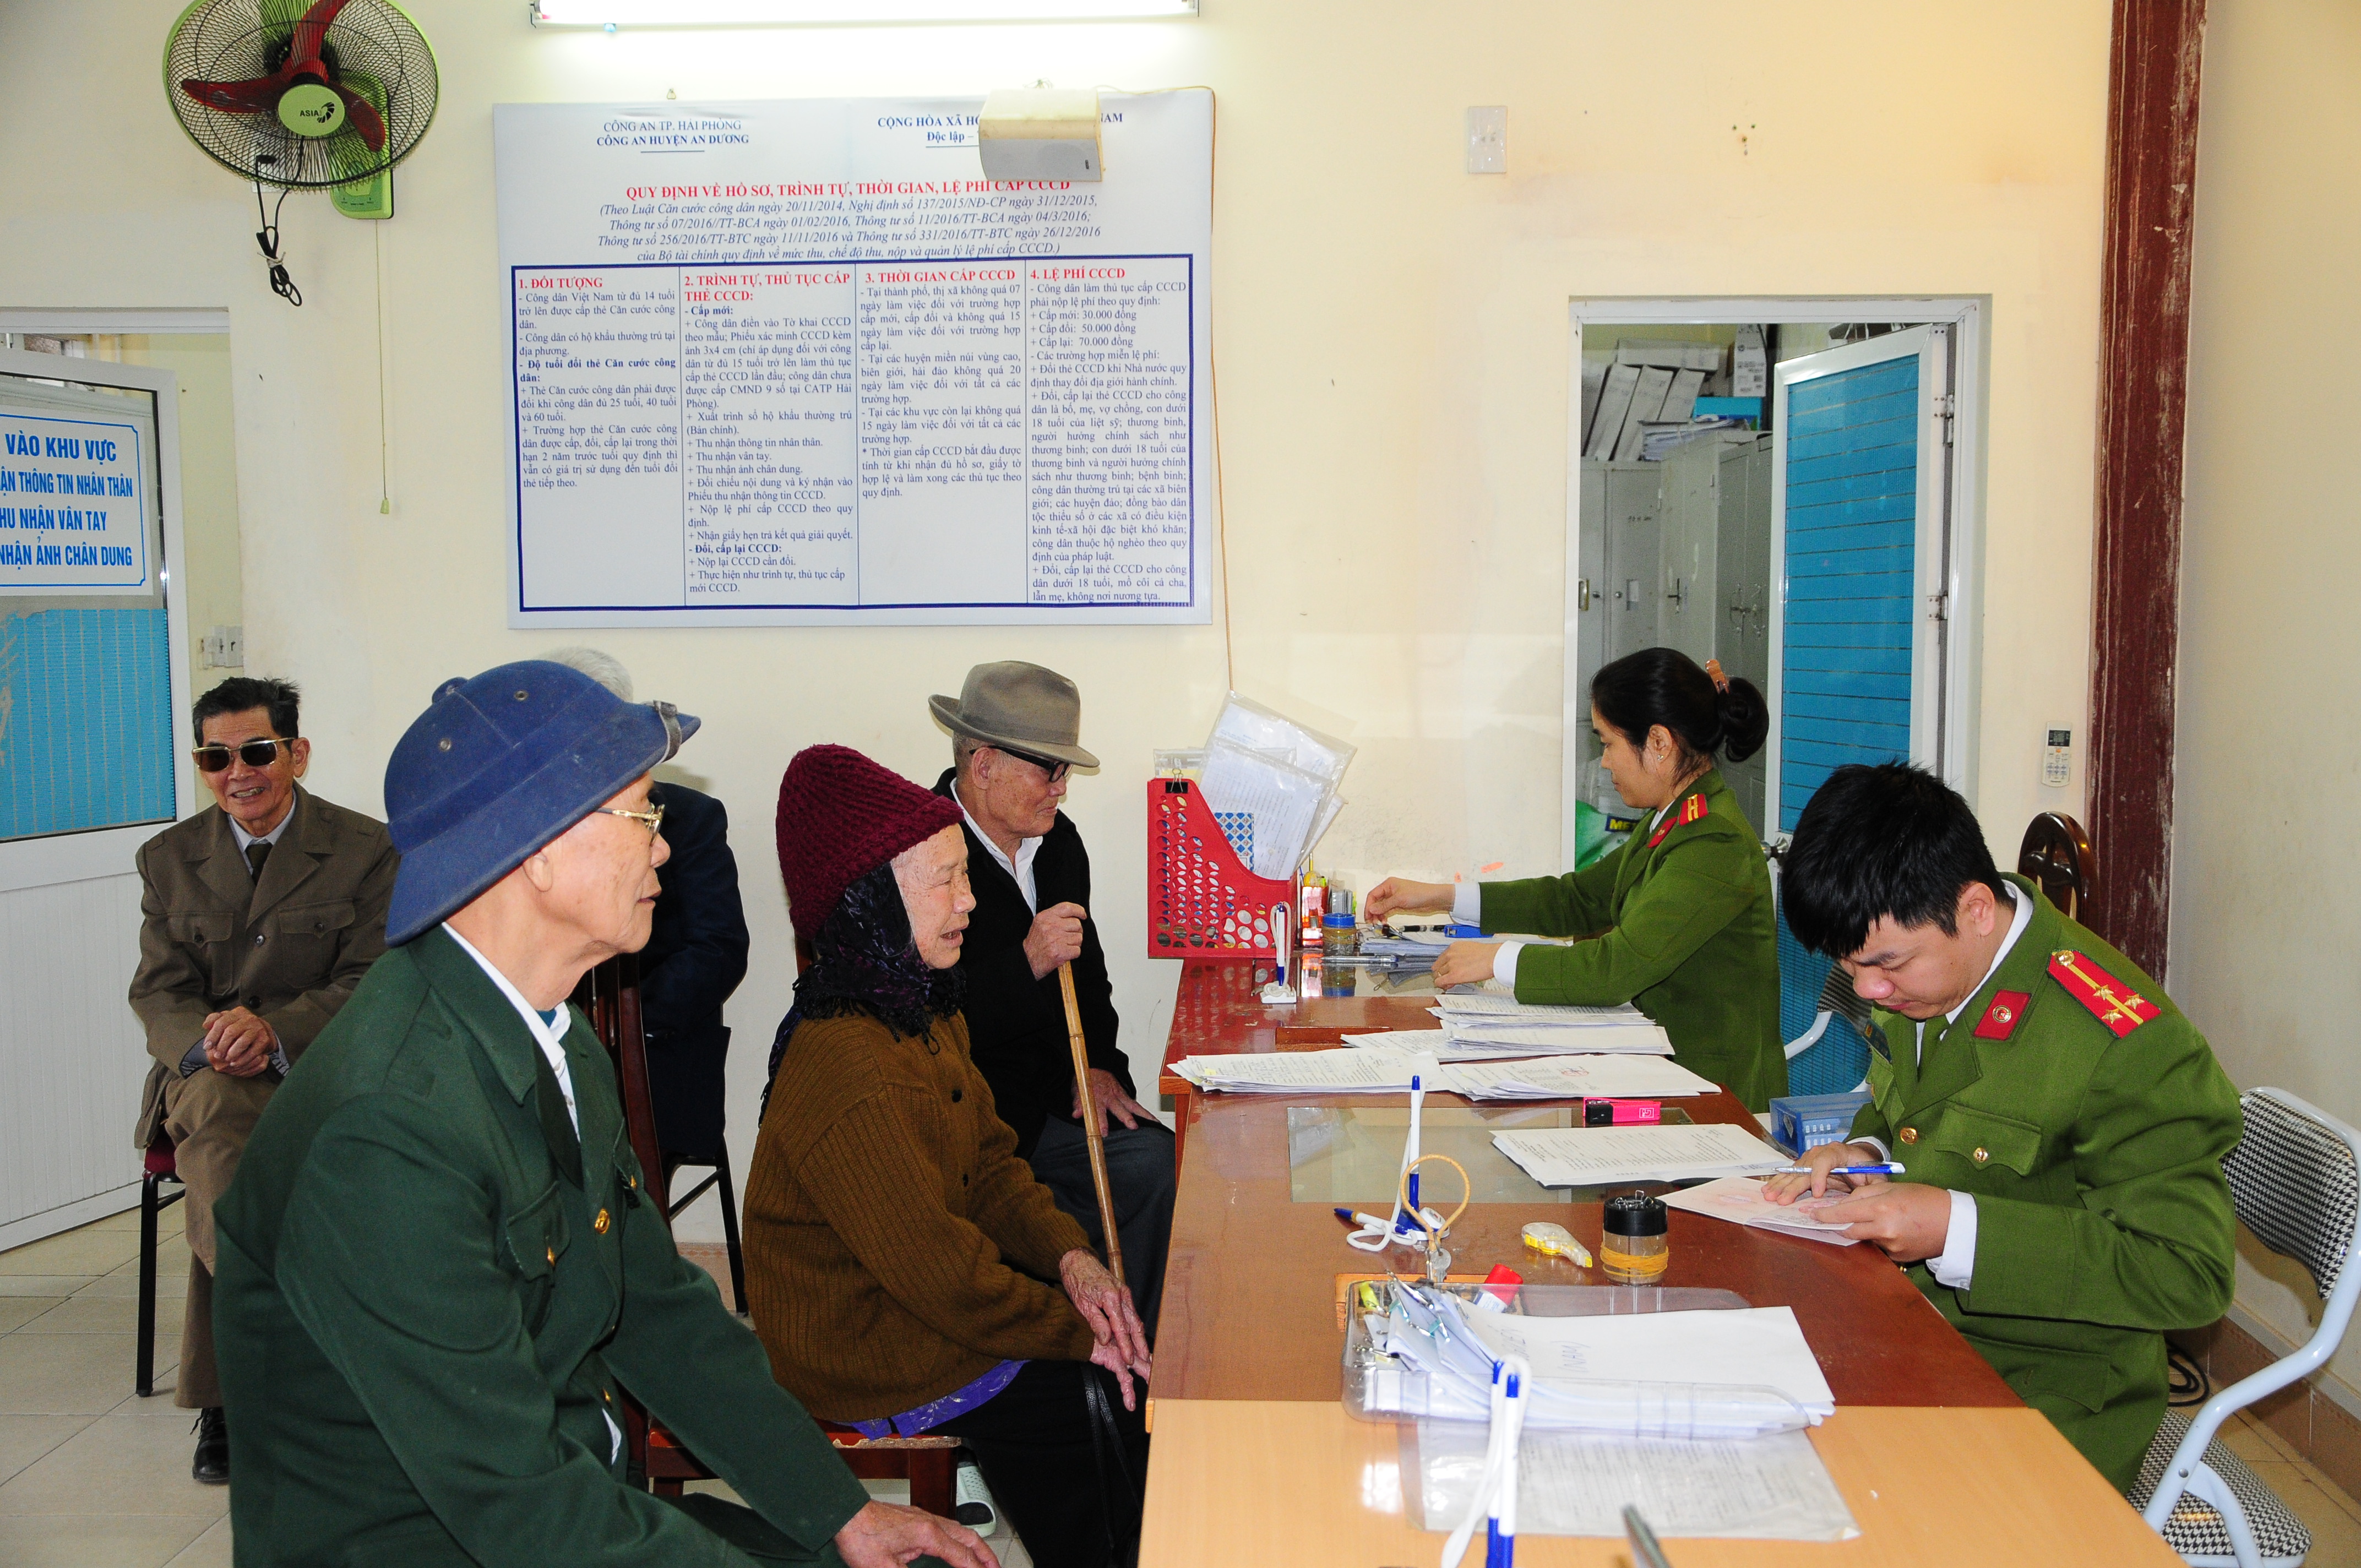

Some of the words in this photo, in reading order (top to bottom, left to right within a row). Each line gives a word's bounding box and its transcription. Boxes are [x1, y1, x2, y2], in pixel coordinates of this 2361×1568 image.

[603, 119, 636, 132] CÔNG
[639, 122, 655, 130] AN
[659, 121, 674, 130] TP.
[678, 119, 698, 130] HẢI
[701, 117, 741, 130] PHÒNG
[878, 116, 913, 129] CỘNG
[916, 115, 942, 127] HÒA
[946, 113, 962, 126] XÃ
[596, 134, 628, 145] CÔNG
[631, 136, 645, 145] AN
[649, 134, 687, 146] HUYỆN
[690, 135, 705, 143] AN
[709, 133, 748, 143] DƯƠNG
[927, 131, 946, 143] Độc
[949, 131, 965, 143] lập
[626, 187, 656, 200] QUY
[662, 186, 697, 200] ĐỊNH
[702, 182, 721, 197] VỀ
[726, 182, 747, 196] HỒ
[751, 184, 773, 197] SƠ,
[777, 181, 823, 195] TRÌNH
[828, 182, 852, 198] TỰ,
[856, 179, 893, 194] THỜI
[897, 182, 938, 194] GIAN,
[943, 181, 960, 195] LỆ
[600, 204, 628, 216] (Theo
[632, 203, 655, 215] Luật
[657, 203, 678, 213] Căn
[681, 202, 706, 213] cước
[708, 202, 733, 215] công
[736, 202, 754, 212] dân
[758, 201, 782, 215] ngày
[785, 200, 845, 212] 20/11/2014,
[848, 199, 873, 213] Nghị
[876, 199, 899, 211] định
[901, 196, 913, 209] số
[917, 197, 1007, 209] 137/2015/NĐ-CP
[1009, 195, 1034, 209] ngày
[1036, 194, 1097, 207] 31/12/2015,
[610, 219, 641, 232] Thông
[644, 221, 655, 229] tư
[656, 215, 668, 229] số
[763, 217, 788, 230] ngày
[791, 215, 850, 228] 01/02/2016,
[855, 215, 886, 228] Thông
[890, 216, 901, 225] tư
[902, 211, 914, 224] số
[918, 213, 1004, 224] 11/2016/TT-BCA
[1008, 211, 1033, 225] ngày
[1035, 210, 1090, 222] 04/3/2016;
[598, 235, 629, 248] Thông
[645, 231, 656, 244] số
[659, 233, 751, 244] 256/2016/TT-BTC
[753, 232, 778, 246] ngày
[782, 231, 838, 242] 11/11/2016
[841, 231, 853, 242] và
[857, 230, 888, 243] Thông
[904, 227, 916, 240] số
[919, 228, 1013, 240] 331/2016/TT-BTC
[1015, 227, 1040, 241] ngày
[1042, 226, 1100, 237] 26/12/2016
[637, 250, 655, 260] của
[658, 250, 672, 263] Bộ
[675, 249, 688, 260] tài
[691, 249, 719, 260] chính
[721, 252, 740, 262] quy
[742, 248, 765, 262] định
[768, 244, 779, 258] về
[782, 248, 803, 258] mức
[807, 247, 825, 260] thu,
[829, 244, 847, 257] chế
[849, 246, 862, 259] độ
[865, 246, 883, 259] thu,
[888, 246, 906, 259] nộp
[910, 246, 922, 255] và
[924, 245, 949, 259] quản
[953, 244, 962, 258] lý
[965, 244, 975, 258] lệ
[977, 243, 994, 258] phí
[997, 241, 1015, 258] cấp
[684, 276, 693, 285] 2.
[697, 272, 737, 285] TRÌNH
[740, 273, 761, 287] TỰ,
[765, 271, 791, 284] THỦ
[795, 274, 821, 286] TỤC
[824, 270, 850, 283] CẤP
[865, 273, 874, 282] 3.
[878, 269, 910, 282] THỜI
[914, 271, 946, 281] GIAN
[950, 268, 976, 281] CẤP
[979, 270, 1015, 280] CCCD
[1030, 269, 1039, 279] 4.
[1043, 267, 1059, 281] LỆ
[1064, 266, 1085, 278] PHÍ
[1089, 268, 1125, 278] CCCD
[520, 279, 527, 288] 1.
[531, 275, 553, 288] ĐỐI
[557, 276, 602, 290] TƯỢNG
[684, 288, 710, 301] THẺ
[714, 290, 753, 301] CCCD:
[1038, 308, 1057, 322] Cấp
[1059, 310, 1079, 319] mới:
[1082, 309, 1112, 319] 30.000
[1114, 308, 1136, 321] đồng
[685, 332, 703, 341] theo
[706, 330, 727, 342] mẫu;
[731, 330, 755, 341] Phiếu
[758, 331, 773, 340] xác
[775, 330, 797, 340] minh
[800, 330, 830, 340] CCCD
[833, 330, 851, 339] kèm
[521, 412, 531, 421] và
[534, 412, 545, 421] 60
[547, 410, 565, 421] tuổi.
[6, 429, 40, 456] VÀO
[45, 437, 79, 459] KHU
[85, 439, 117, 466] VỰC
[0, 466, 16, 497] ẬN
[18, 468, 54, 493] THÔNG
[56, 472, 74, 495] TIN
[77, 471, 105, 496] NHÂN
[107, 472, 133, 498] THÂN
[862, 489, 879, 499] quy
[880, 487, 902, 498] định.
[0, 508, 15, 529] HU
[19, 504, 55, 534] NHẬN
[58, 506, 82, 531] VÂN
[86, 510, 107, 532] TAY
[0, 540, 32, 570] NHẬN
[36, 536, 62, 565] ẢNH
[65, 541, 98, 565] CHÂN
[101, 546, 133, 566] DUNG
[1033, 590, 1046, 600] lẫn
[1067, 591, 1094, 602] không
[1096, 591, 1111, 599] nơi
[1113, 593, 1141, 601] nương
[1144, 592, 1160, 601] tựa.
